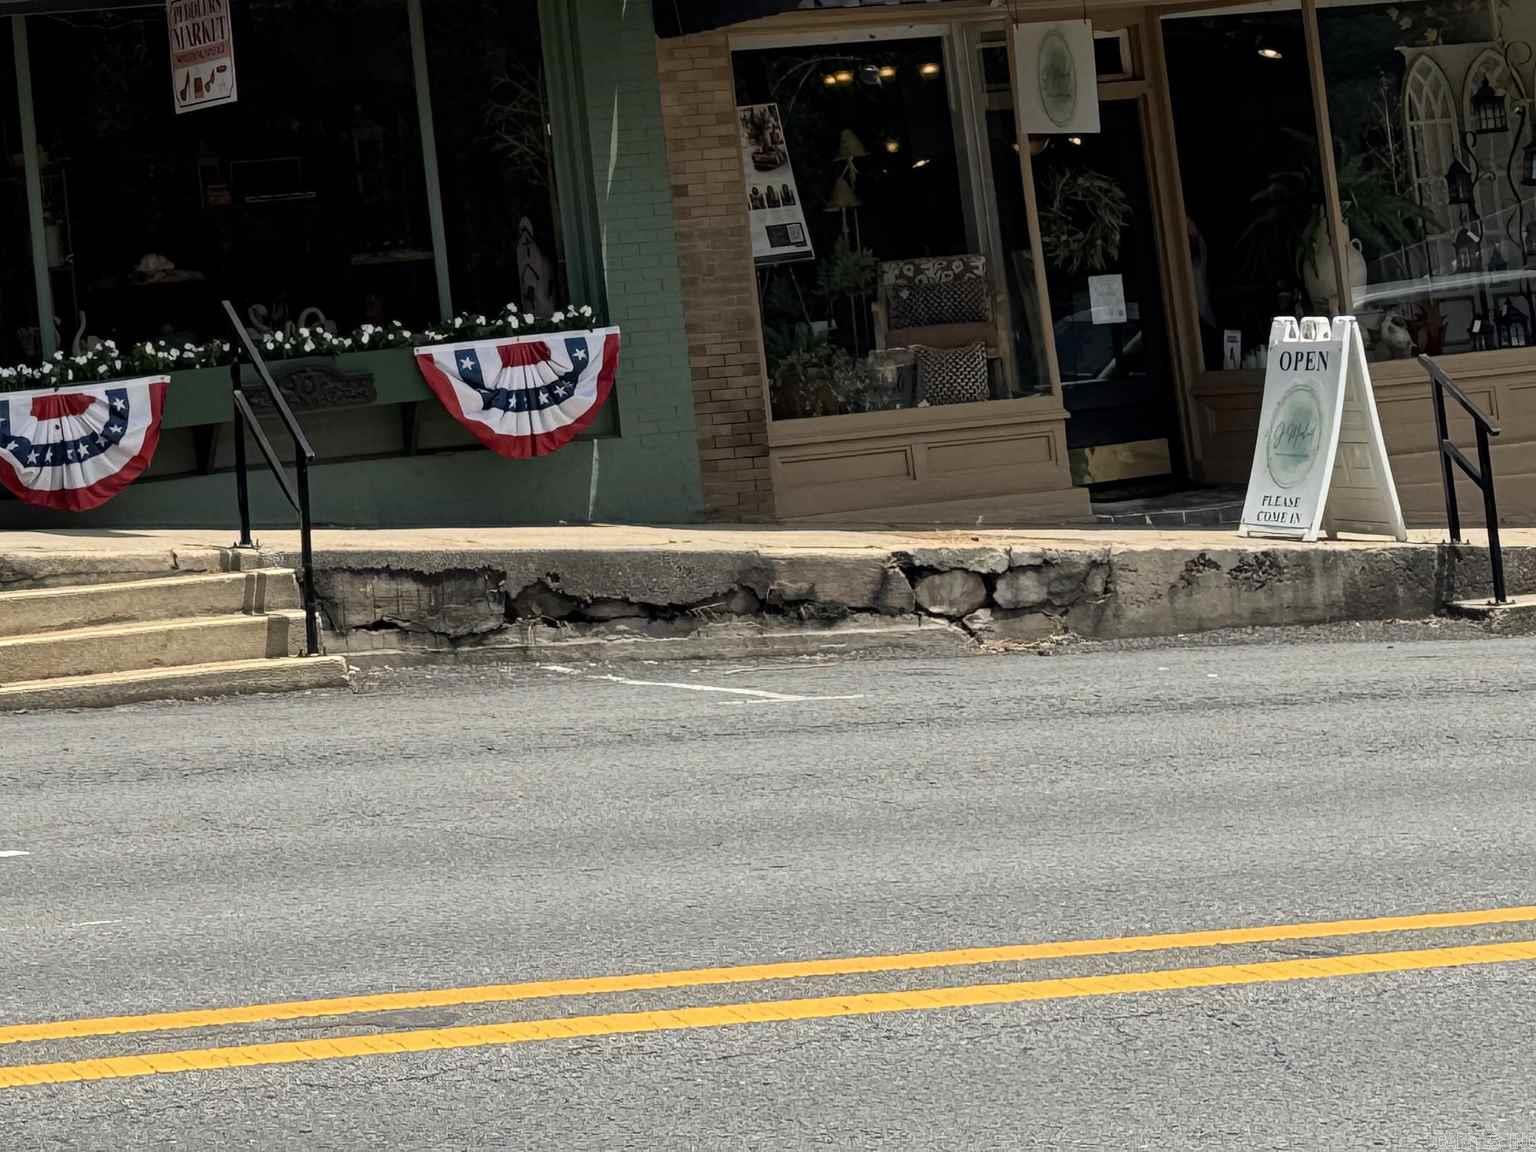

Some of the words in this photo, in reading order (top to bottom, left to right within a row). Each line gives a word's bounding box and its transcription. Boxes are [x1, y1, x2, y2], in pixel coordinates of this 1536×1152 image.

[174, 16, 225, 50] MARKET
[1279, 350, 1329, 371] OPEN
[1261, 495, 1302, 508] PLEASE
[1257, 510, 1288, 524] COME
[1289, 511, 1302, 525] IN
